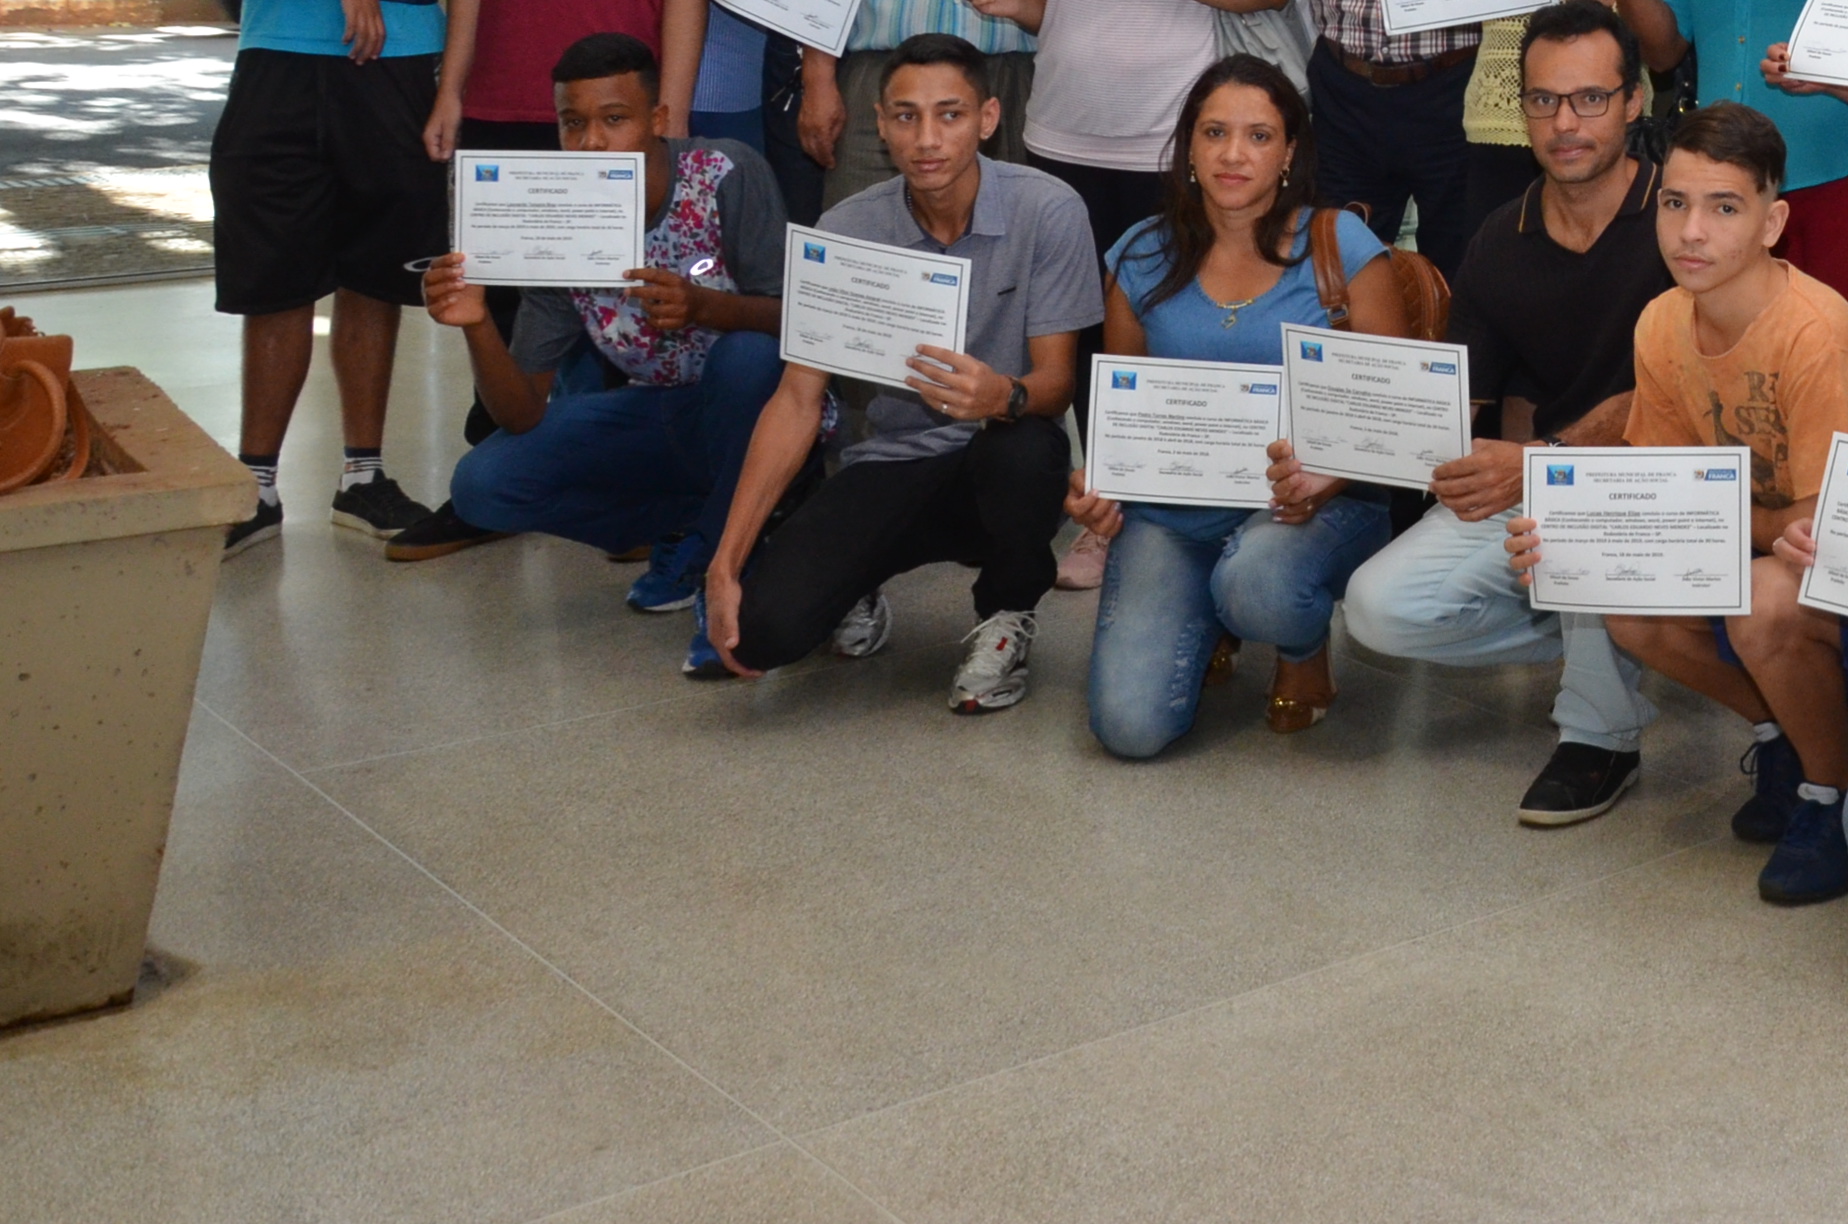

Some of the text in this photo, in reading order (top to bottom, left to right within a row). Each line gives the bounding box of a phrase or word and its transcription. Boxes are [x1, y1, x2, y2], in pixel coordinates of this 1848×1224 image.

[851, 276, 889, 290] CERTIFICADO
[1351, 373, 1390, 384] CERTIFICADO
[1165, 398, 1207, 407] CERTIFICADO
[1608, 492, 1656, 500] CERTIFICADO
